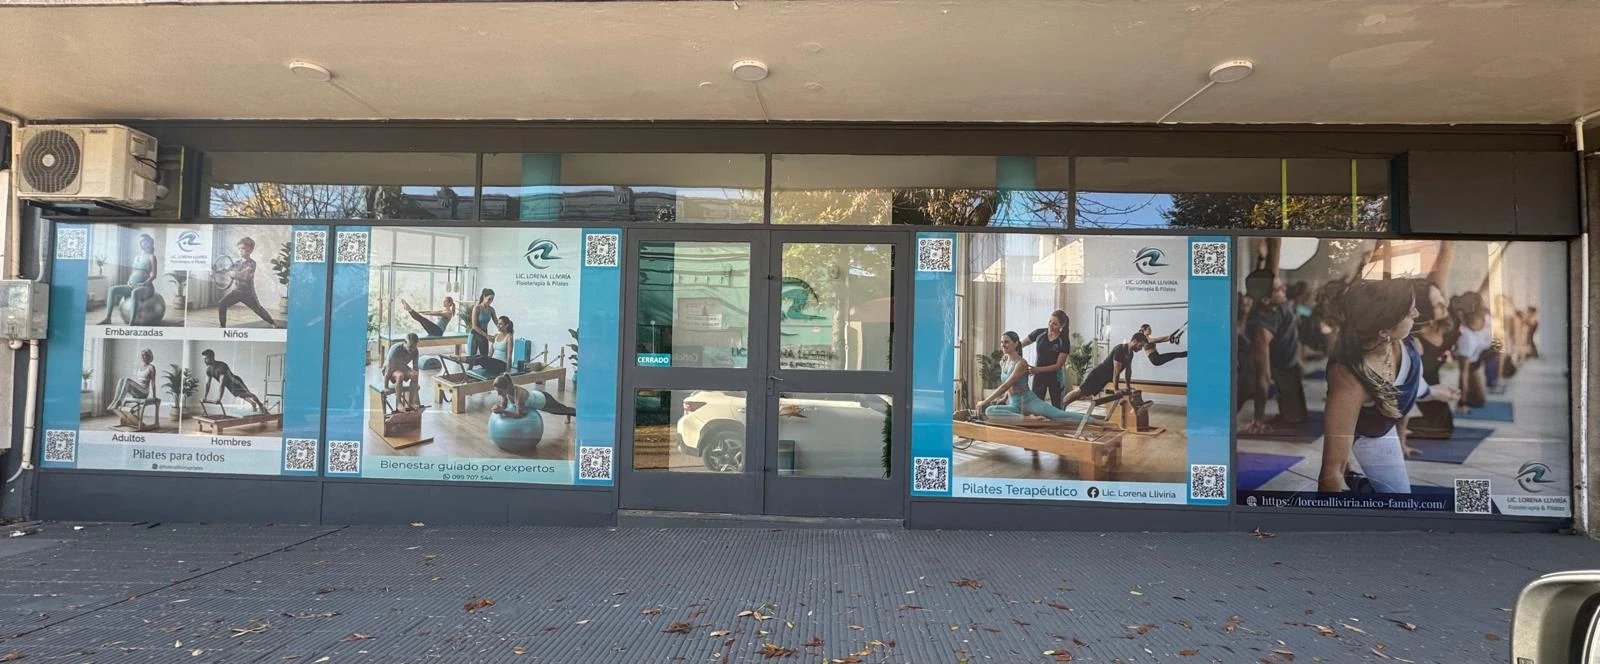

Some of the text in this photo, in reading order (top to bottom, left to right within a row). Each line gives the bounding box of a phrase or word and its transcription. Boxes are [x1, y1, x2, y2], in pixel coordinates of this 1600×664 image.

[105, 327, 164, 337] Embarazadas
[223, 330, 249, 339] Niños
[637, 356, 669, 364] CERRADO
[112, 433, 146, 443] Adultos
[210, 437, 252, 447] Hombres
[133, 448, 225, 462] Pilates para todos
[380, 460, 555, 474] Bienestar guiado por expertos
[962, 483, 1078, 498] Pilates Terapéutico
[1118, 489, 1147, 498] Lorena
[1262, 495, 1447, 511] https://lorenalliviria.nico-family.com/
